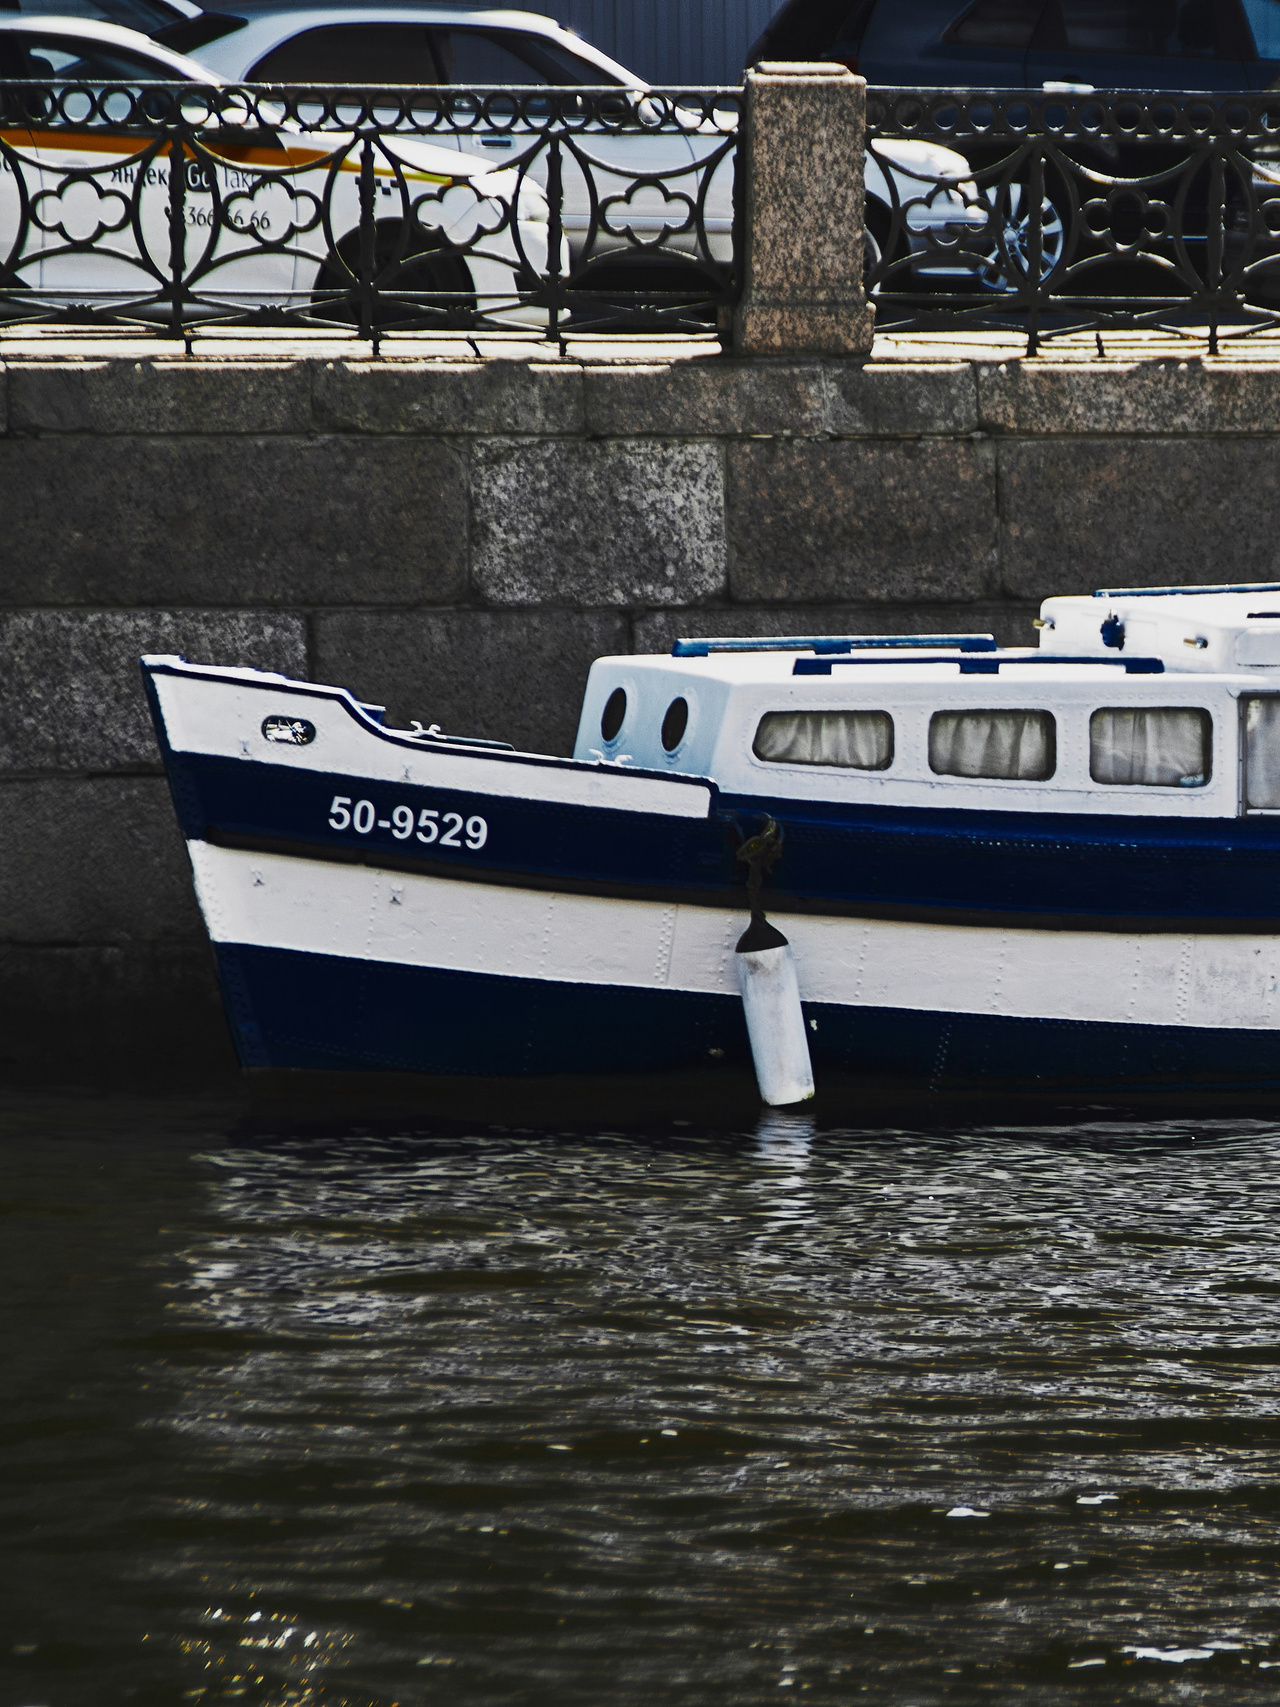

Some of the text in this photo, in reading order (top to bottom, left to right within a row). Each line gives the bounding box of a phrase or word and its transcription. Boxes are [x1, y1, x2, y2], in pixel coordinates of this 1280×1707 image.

[111, 164, 168, 186] Янек
[222, 164, 272, 189] Так
[328, 796, 488, 849] 50-9529
